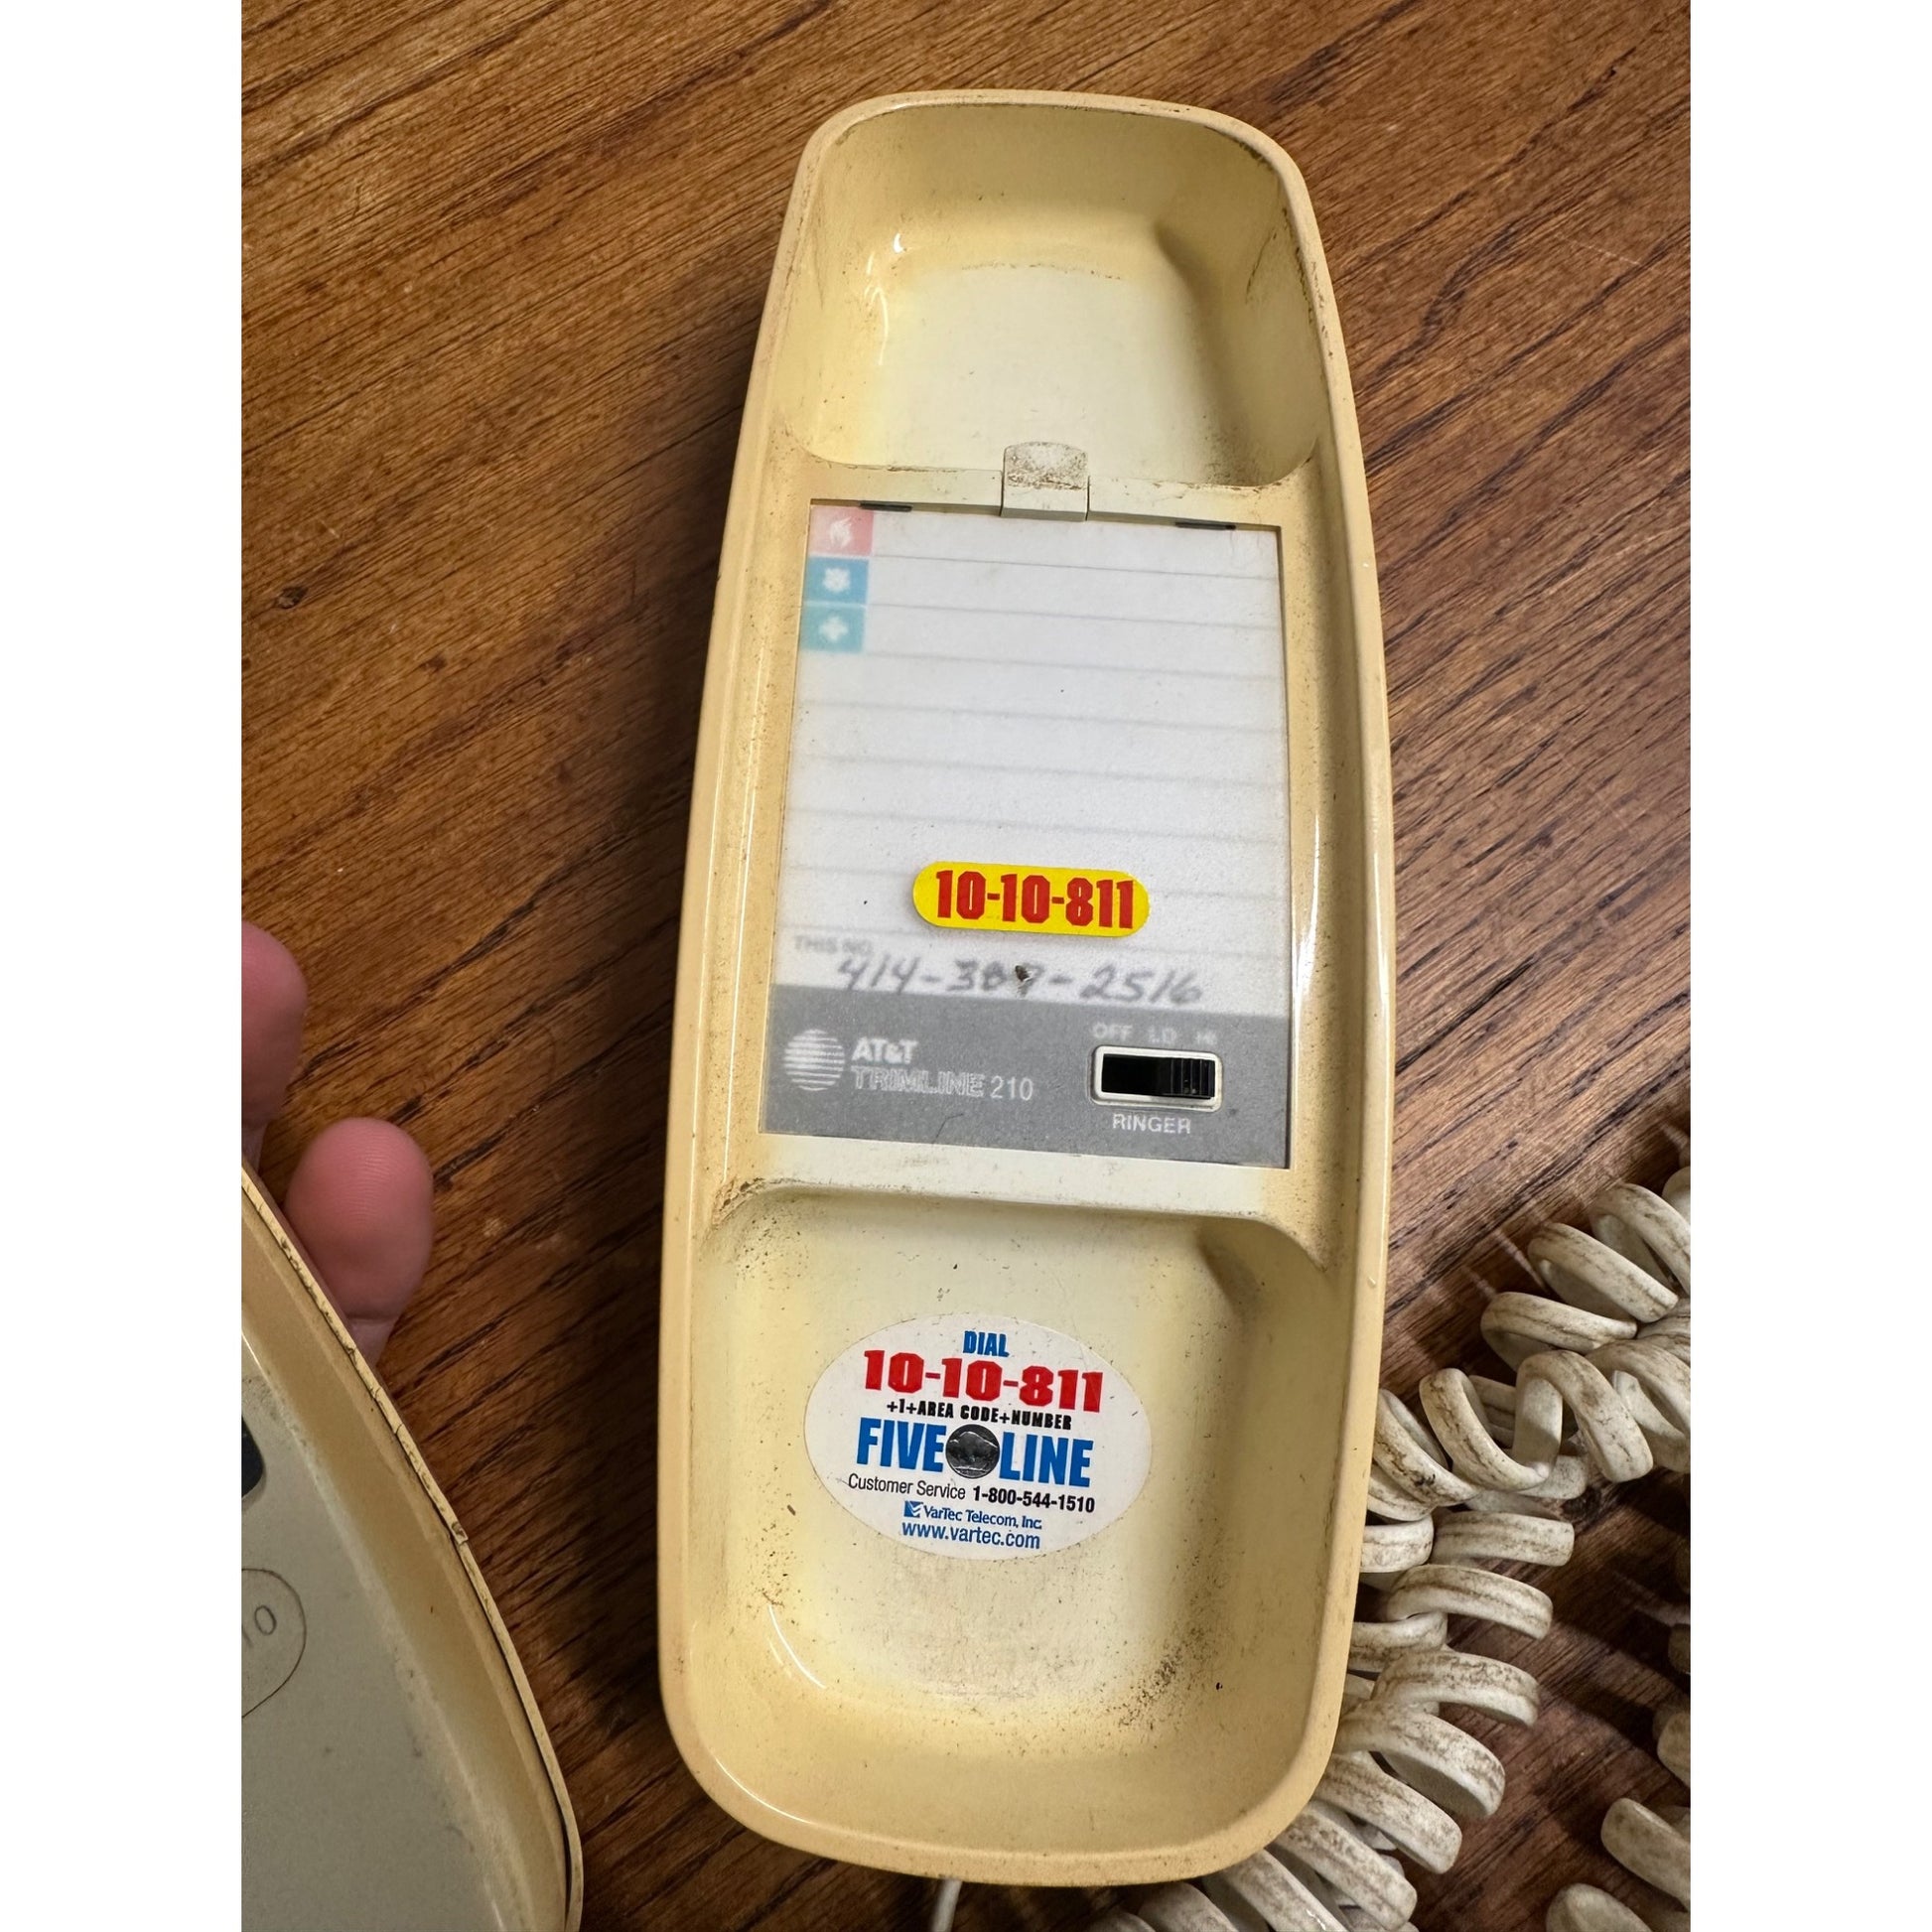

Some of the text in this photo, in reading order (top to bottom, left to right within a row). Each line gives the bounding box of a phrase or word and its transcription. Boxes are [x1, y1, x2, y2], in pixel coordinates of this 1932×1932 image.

[935, 870, 1134, 929] 10-10-811
[793, 934, 839, 954] THIS
[1092, 1023, 1133, 1040] OFF
[851, 1036, 919, 1065] AT&T
[851, 1065, 1034, 1101] TRIMLINE 210
[1112, 1113, 1191, 1134] RINGER
[962, 1330, 1010, 1357] DIAL
[864, 1349, 1103, 1413] 10-10-811
[887, 1398, 1072, 1430] +1+AREA CODE+NUMBER
[856, 1417, 1094, 1487] FIVE LINE
[848, 1473, 1095, 1514] Customer Service 1-800-544-1510
[923, 1505, 963, 1521] VarTec
[965, 1509, 1019, 1528] Telecom,
[901, 1522, 1040, 1549] www.vartec.com
